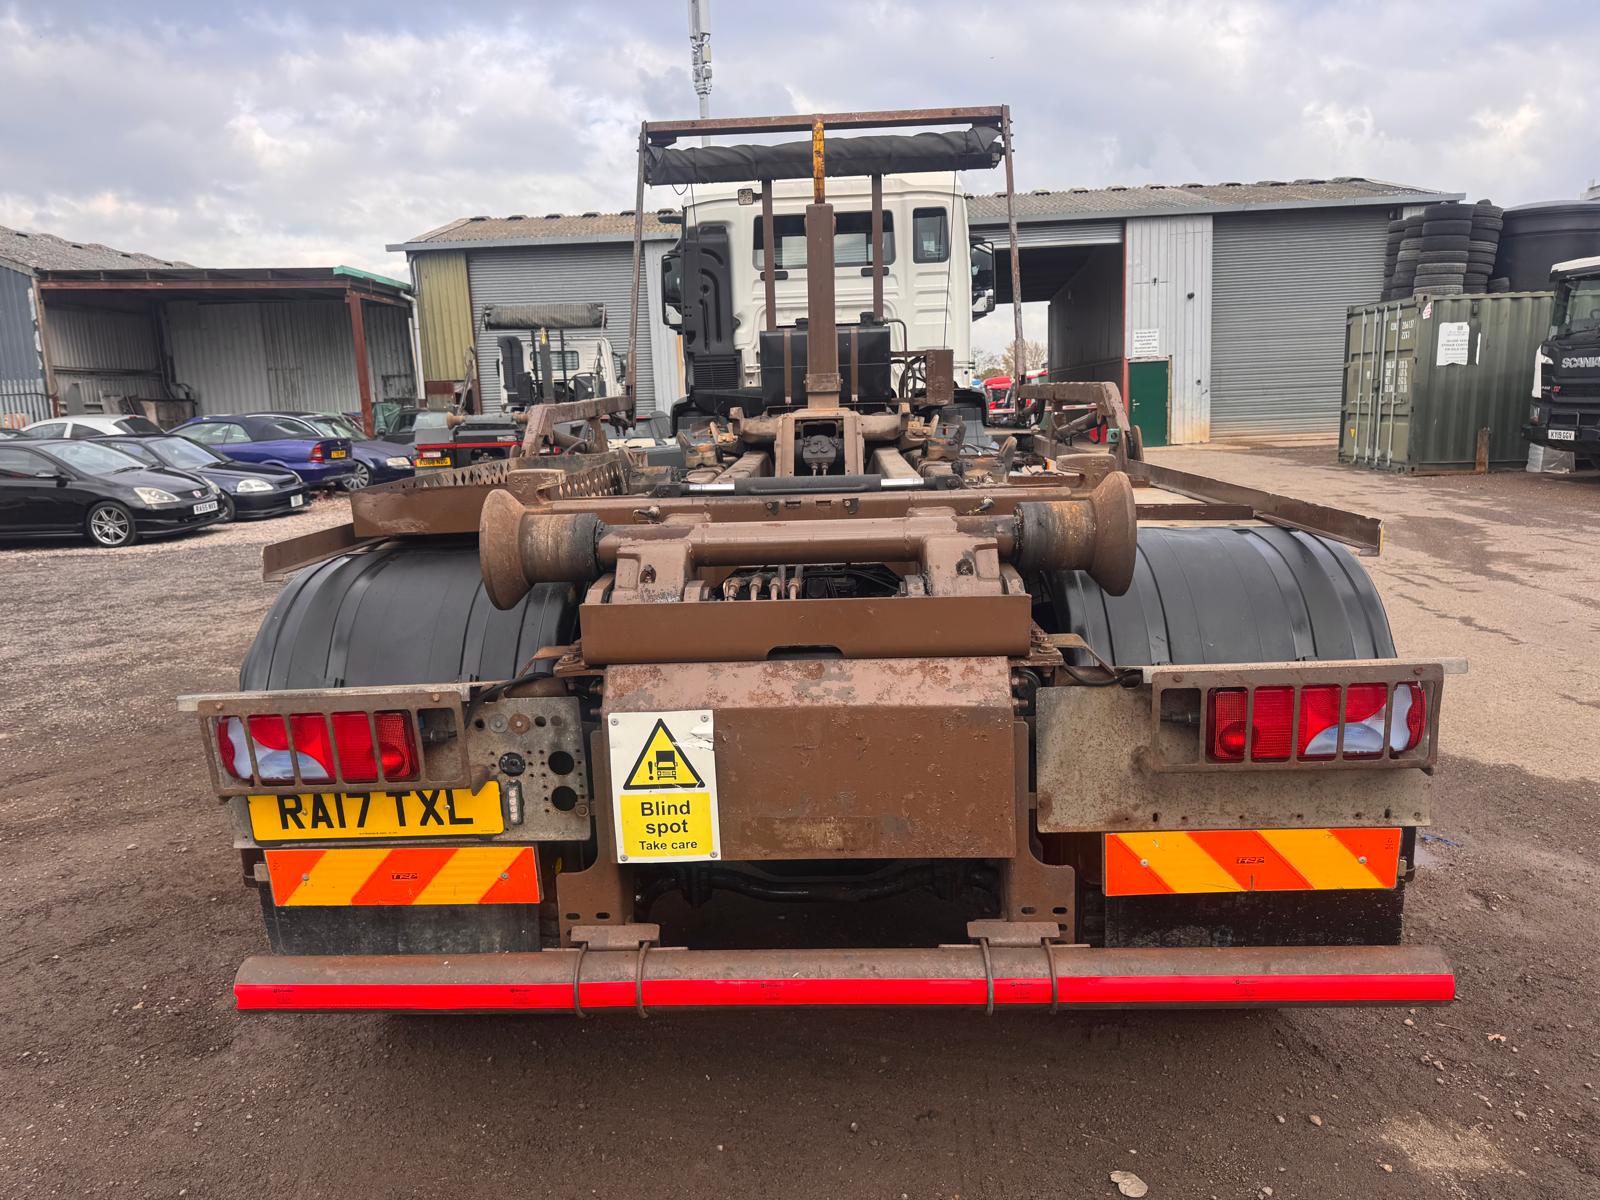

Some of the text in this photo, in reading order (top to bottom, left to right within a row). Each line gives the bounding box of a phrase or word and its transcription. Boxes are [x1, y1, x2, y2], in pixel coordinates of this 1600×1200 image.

[276, 789, 474, 830] RA17 TXL
[641, 800, 691, 817] Blind
[646, 819, 689, 837] spot
[639, 841, 698, 850] Take care
